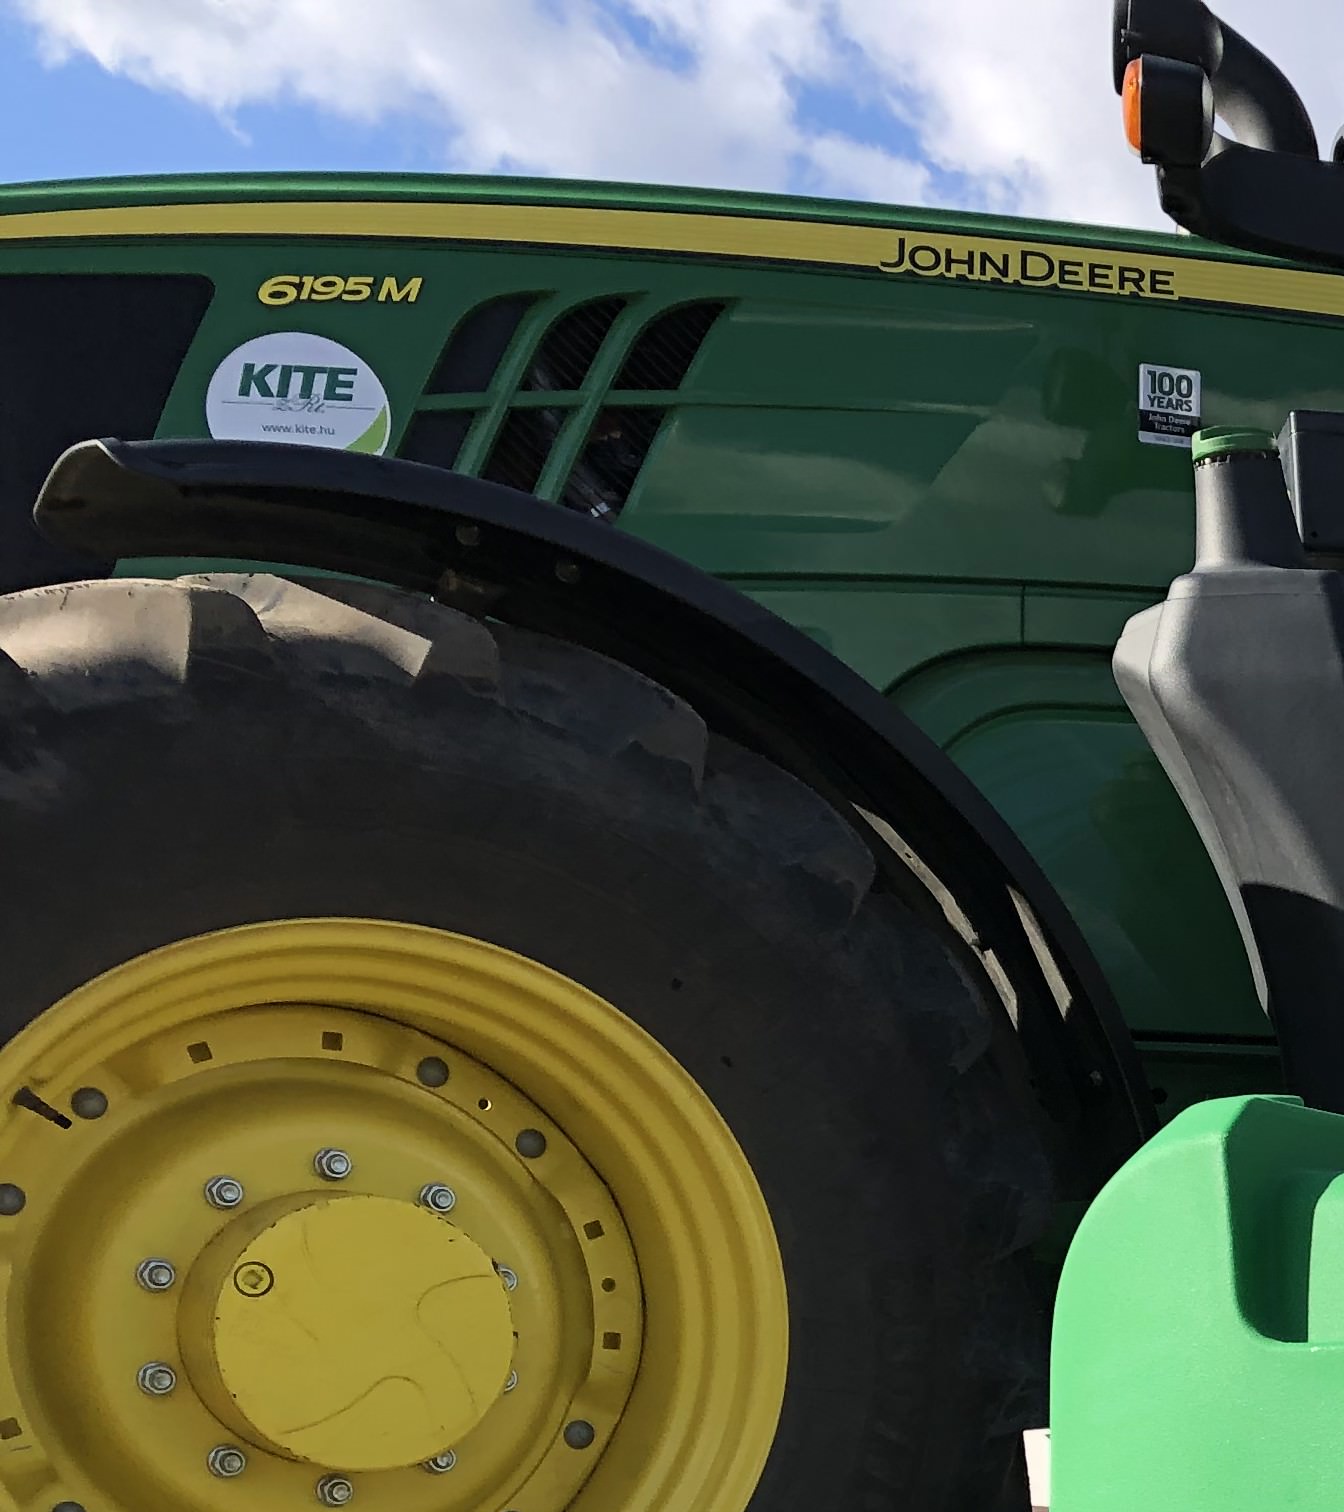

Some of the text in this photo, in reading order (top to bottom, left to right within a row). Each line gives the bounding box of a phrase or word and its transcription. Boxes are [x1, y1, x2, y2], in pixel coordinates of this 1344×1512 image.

[880, 237, 1175, 296] JOHN DEERE
[238, 362, 358, 402] KITE
[1146, 369, 1193, 399] 100
[1146, 394, 1193, 413] YEARS
[261, 423, 336, 436] www.kite.hu
